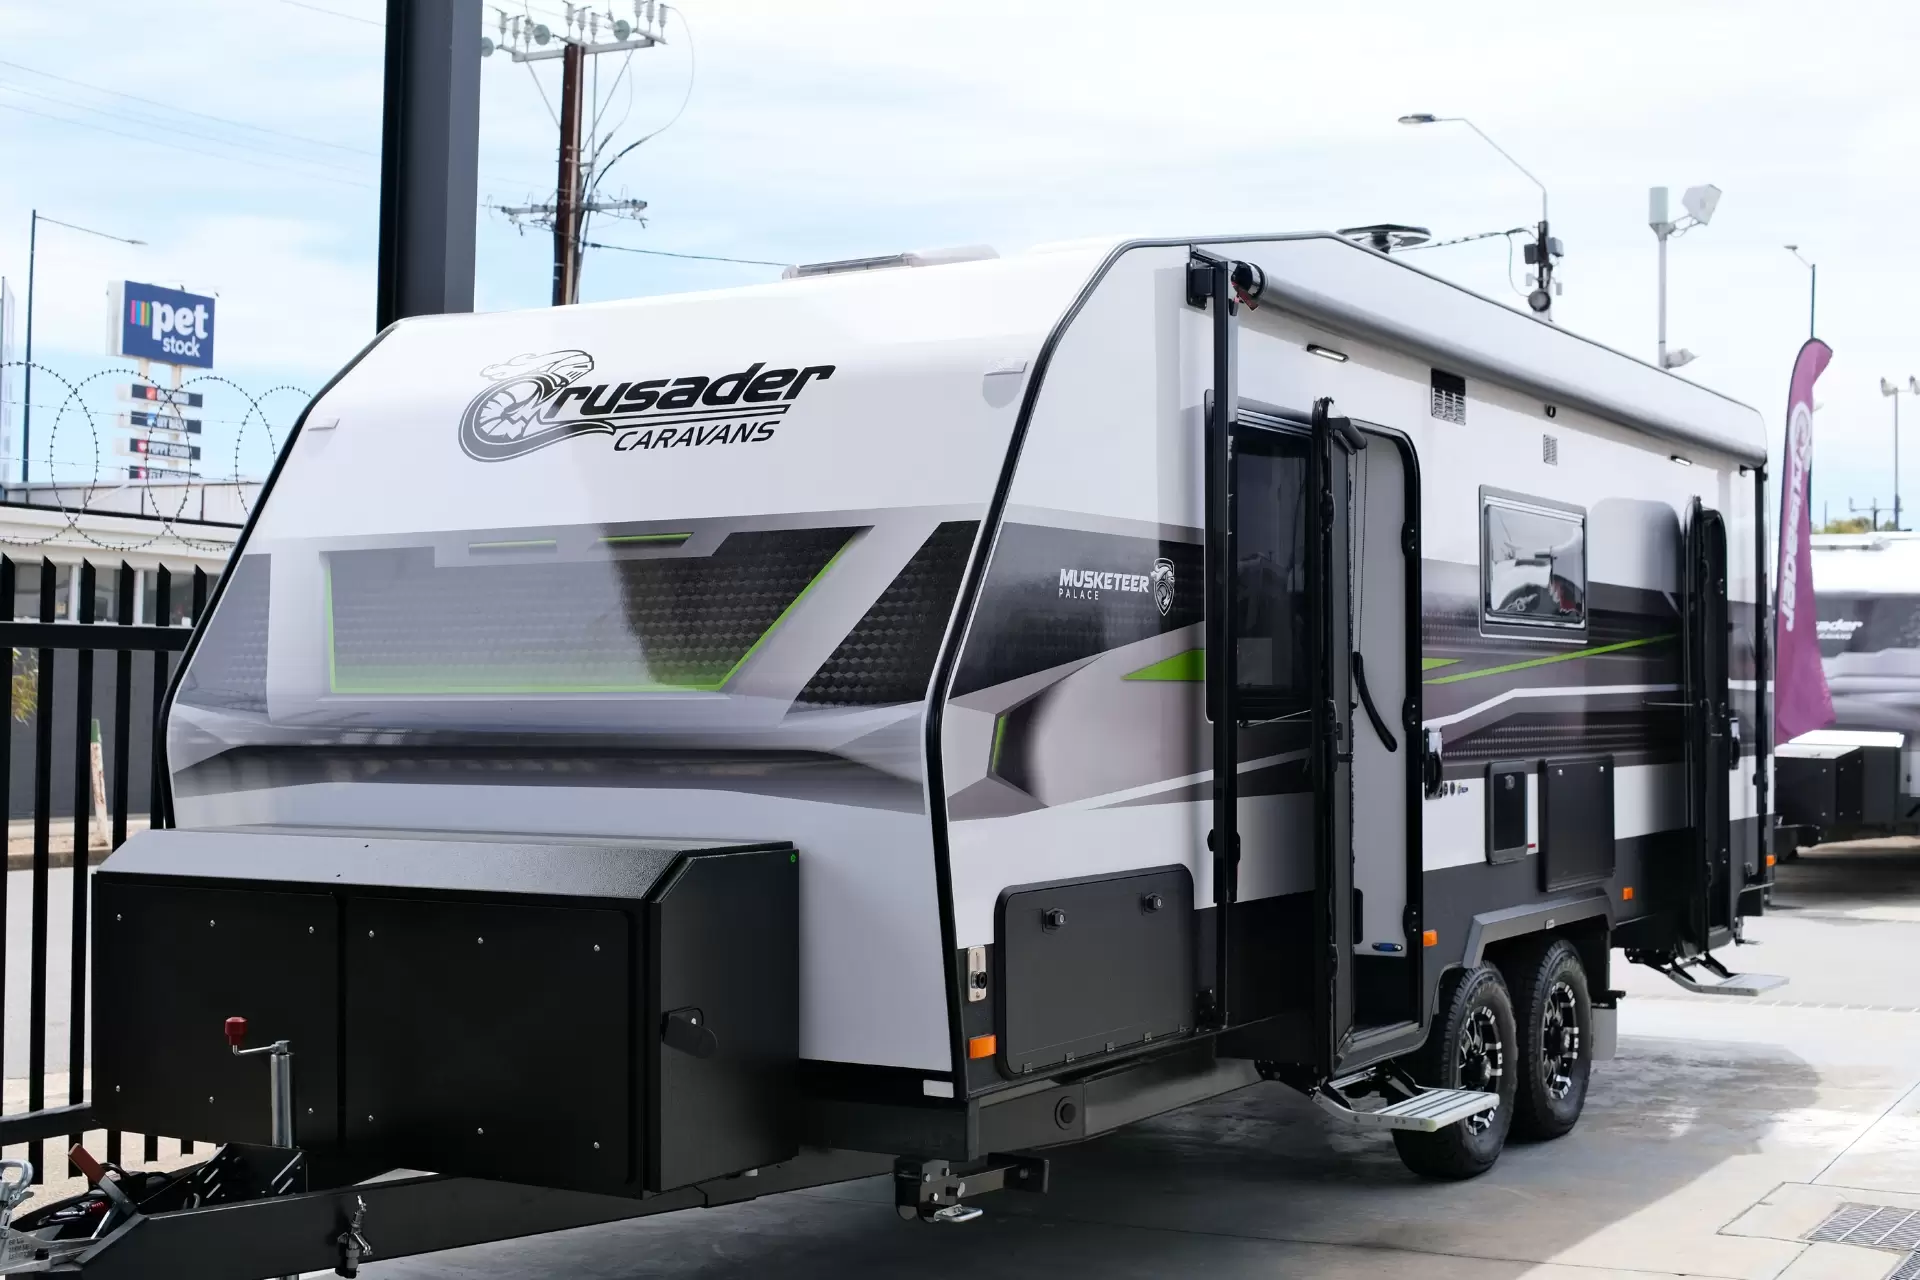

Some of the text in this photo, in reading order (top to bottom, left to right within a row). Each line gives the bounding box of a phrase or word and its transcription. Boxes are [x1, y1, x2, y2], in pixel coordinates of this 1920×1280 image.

[152, 301, 209, 340] pet
[162, 336, 200, 357] stock
[613, 420, 780, 451] CARAVANS
[1059, 569, 1150, 592] MUSKETEER
[1059, 588, 1099, 600] PALACE
